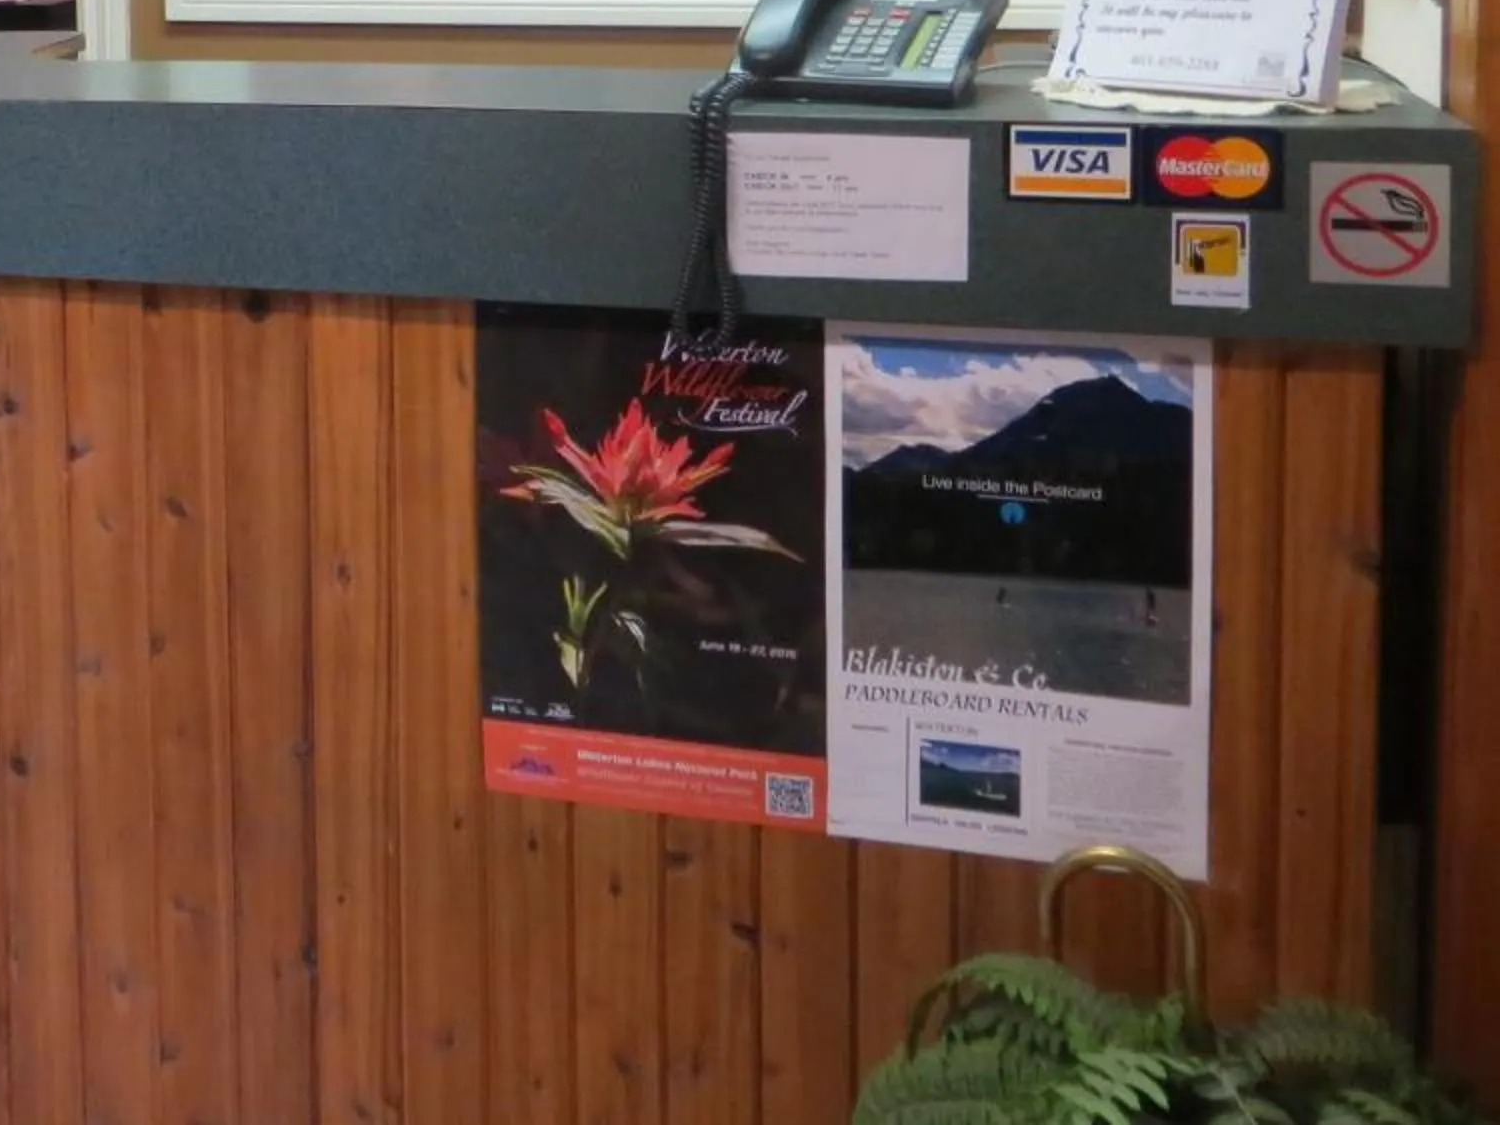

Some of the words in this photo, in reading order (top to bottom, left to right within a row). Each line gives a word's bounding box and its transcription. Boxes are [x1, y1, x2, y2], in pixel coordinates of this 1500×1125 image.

[1031, 148, 1110, 174] VISA
[1158, 159, 1270, 178] MasterCard
[703, 388, 808, 425] Festival
[922, 475, 952, 488] Live
[956, 477, 1000, 492] inside
[1004, 480, 1029, 494] the
[1033, 481, 1103, 500] Postcard
[847, 647, 963, 683] Blakiston
[845, 683, 992, 713] PADDLEBOARD
[999, 698, 1090, 725] RENTALS
